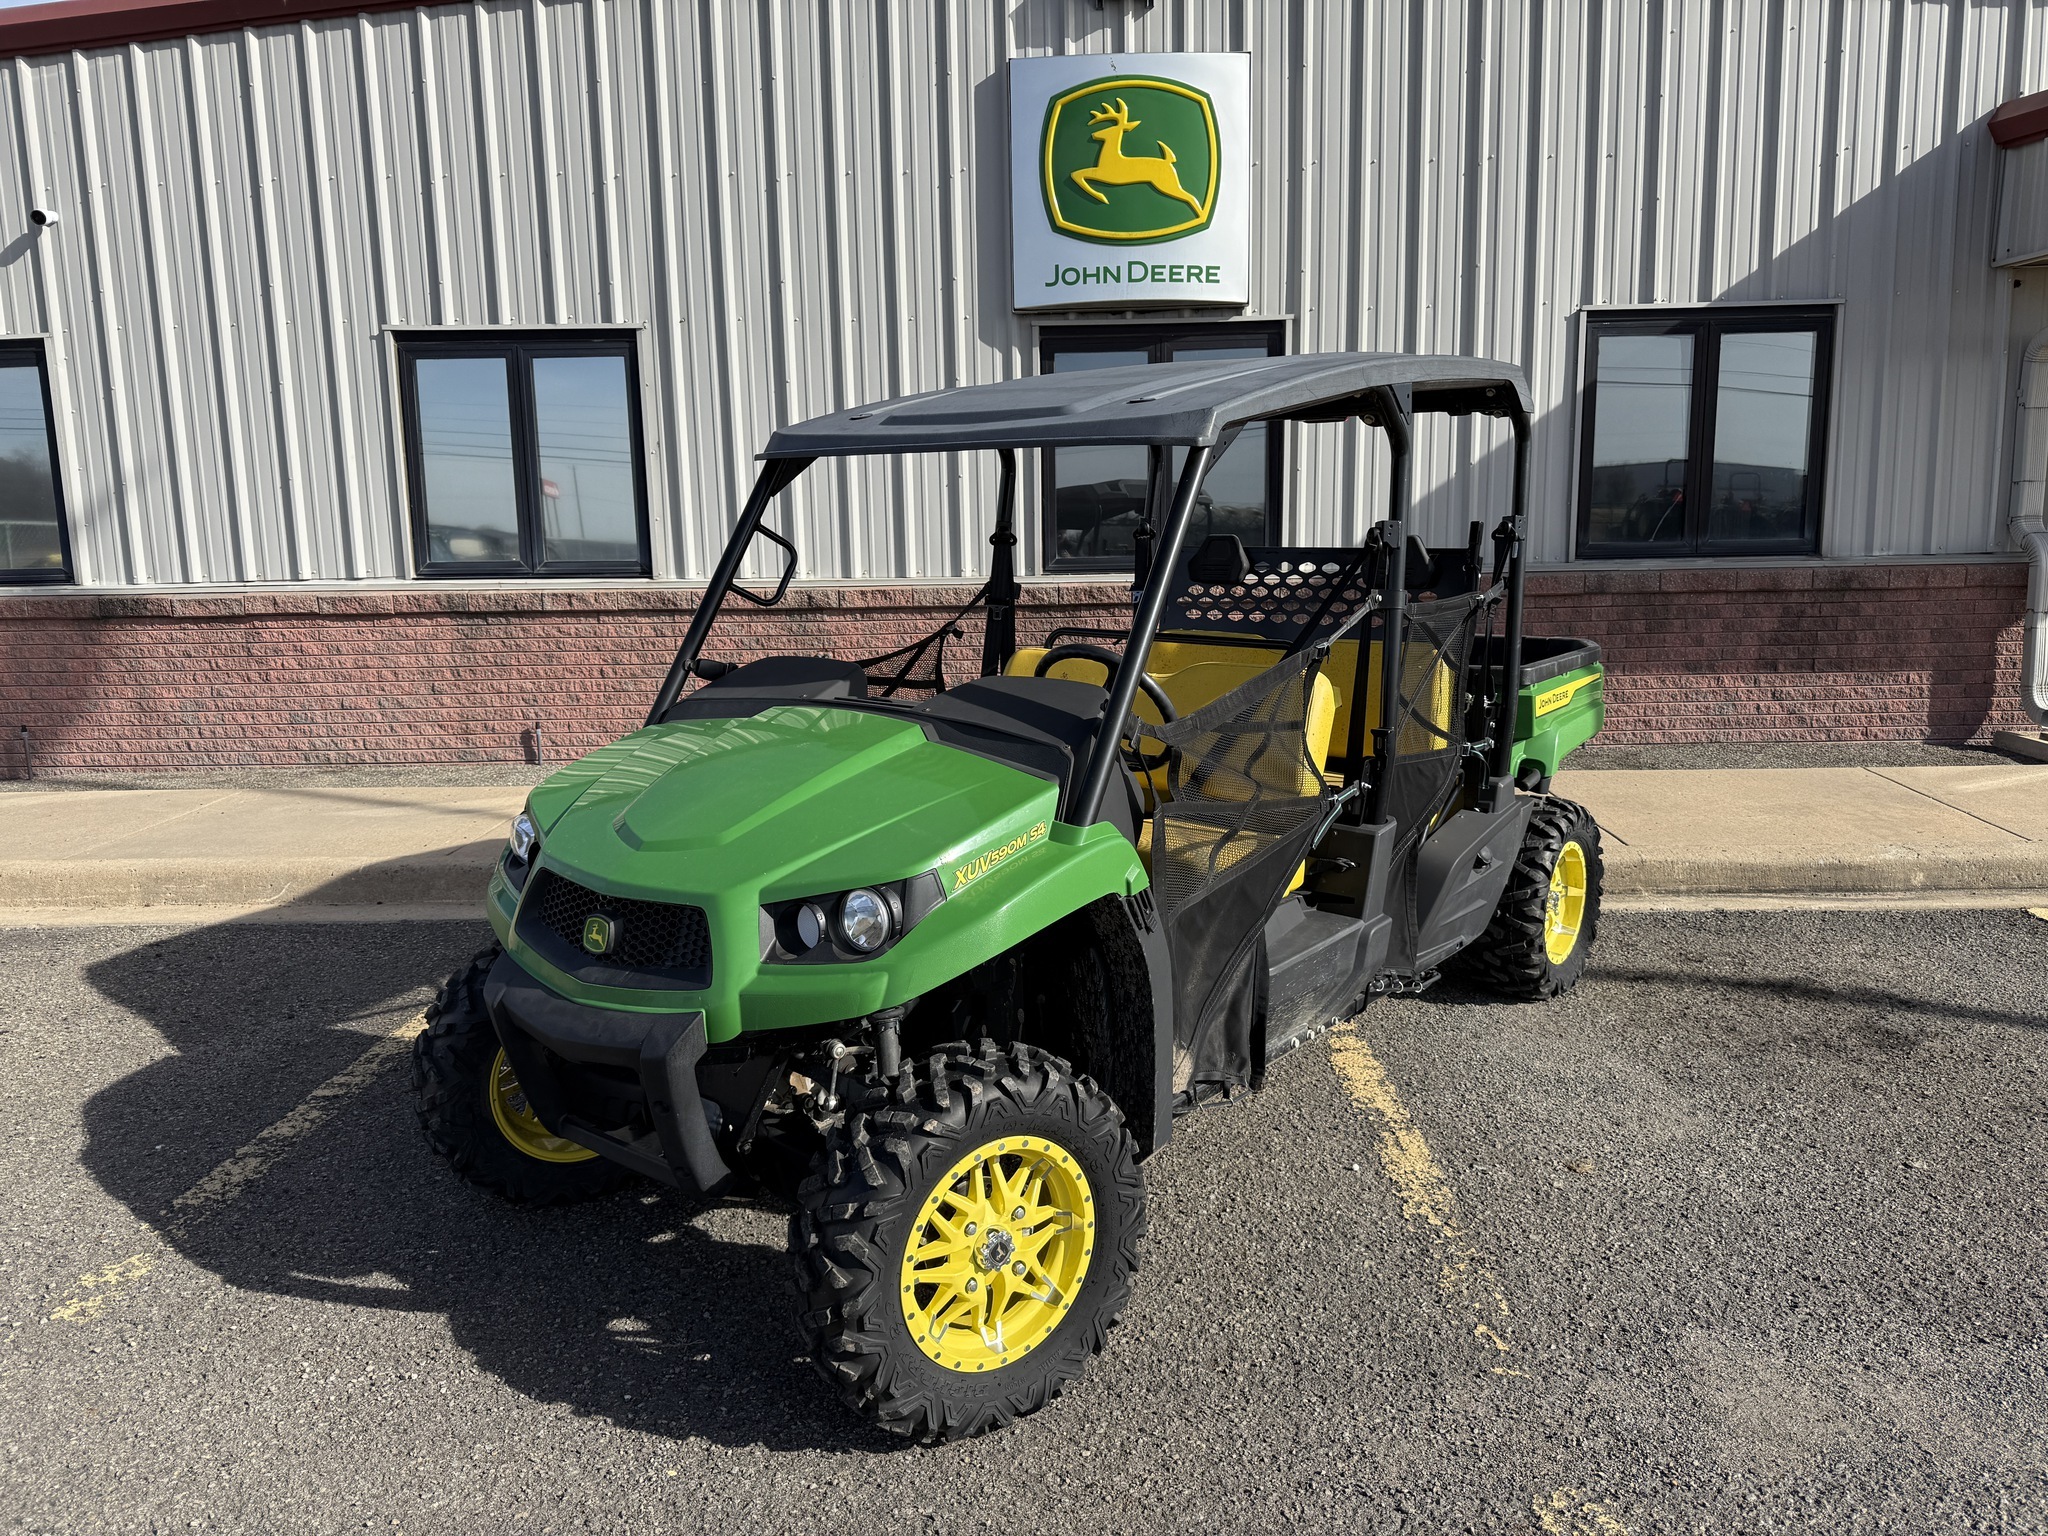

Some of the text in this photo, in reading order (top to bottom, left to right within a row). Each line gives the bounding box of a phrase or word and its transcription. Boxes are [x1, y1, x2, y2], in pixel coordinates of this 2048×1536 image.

[1045, 260, 1221, 287] JOHN DEERE
[1539, 690, 1569, 709] JOHN DEERE
[1029, 820, 1047, 842] S4
